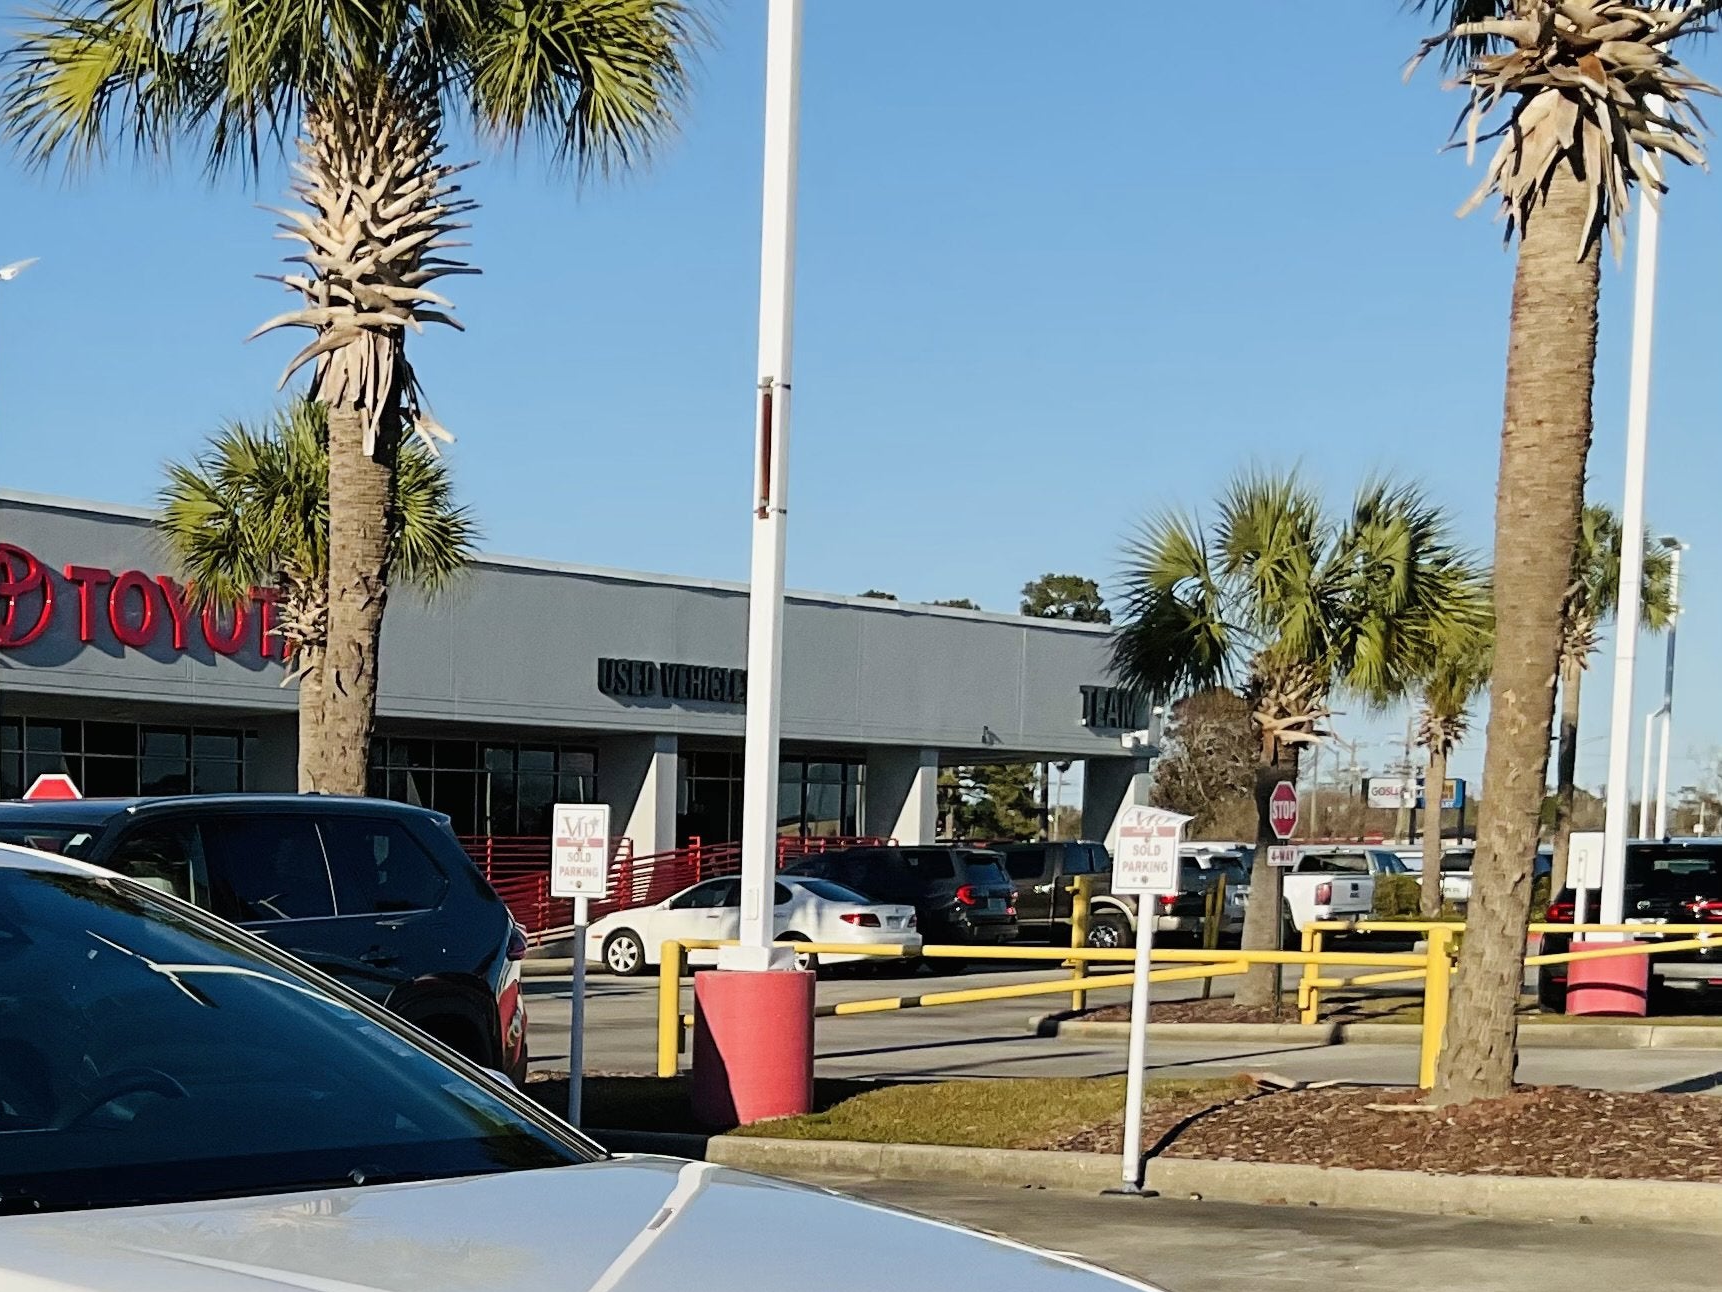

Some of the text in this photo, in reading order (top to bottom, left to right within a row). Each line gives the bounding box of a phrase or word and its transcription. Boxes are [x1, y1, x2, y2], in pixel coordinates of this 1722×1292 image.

[64, 564, 296, 661] TOYOT
[598, 658, 749, 704] USED VEHICLE
[1079, 686, 1142, 729] TEAM
[1272, 800, 1296, 820] STOP
[1132, 844, 1161, 857] SOLD
[1271, 850, 1294, 862] 4-WAY
[567, 852, 591, 863] SOLD
[559, 865, 599, 878] PARKING
[1122, 860, 1168, 873] PARKING
